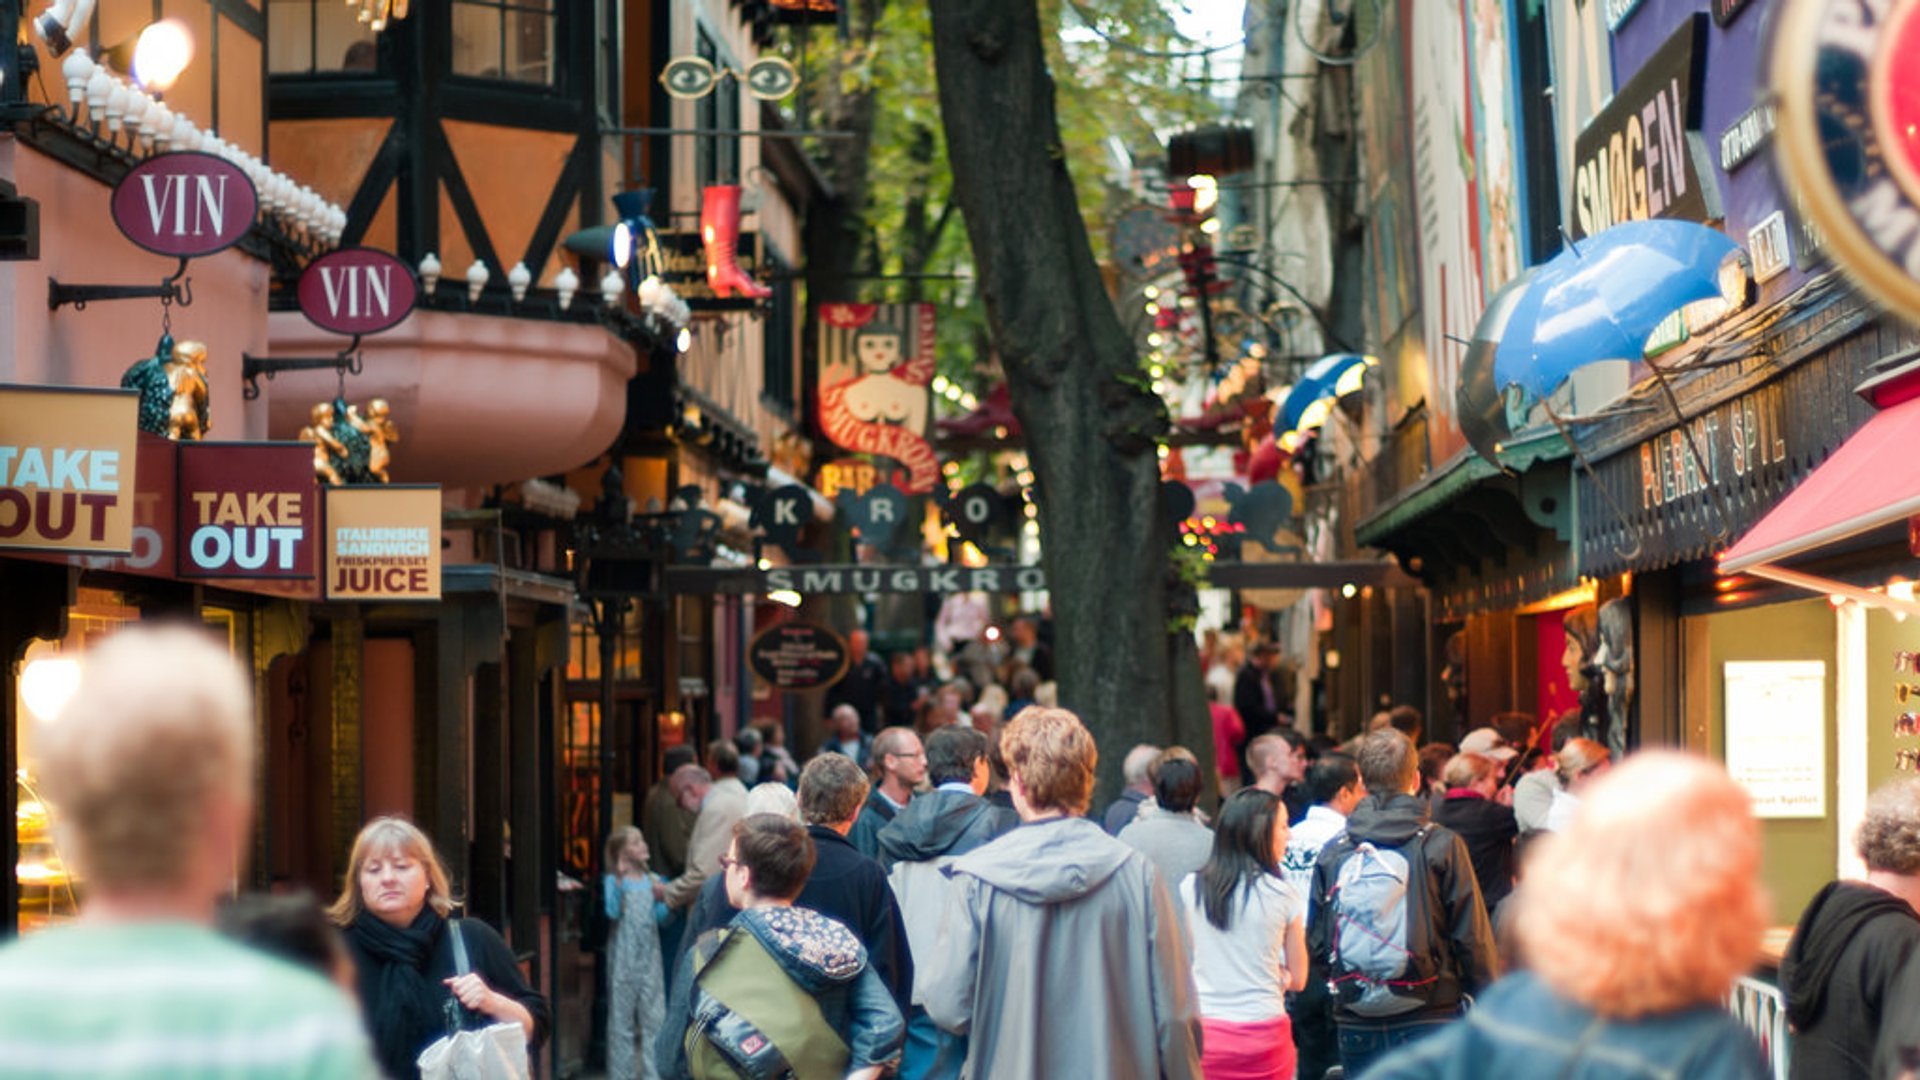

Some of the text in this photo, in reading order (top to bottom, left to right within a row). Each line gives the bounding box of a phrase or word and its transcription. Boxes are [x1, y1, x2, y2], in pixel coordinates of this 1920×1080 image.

[1577, 78, 1686, 238] SMØGEN
[139, 174, 228, 237] VIN
[318, 265, 391, 319] VIN
[1731, 385, 1785, 476] SPIL
[0, 489, 117, 541] OUT
[193, 492, 303, 526] TAKE
[190, 525, 304, 569] OUT
[336, 528, 429, 541] ITALIENSKE
[336, 542, 430, 556] SANDWICH
[334, 568, 429, 593] JUICE
[336, 557, 428, 566] FRISKPRESSET
